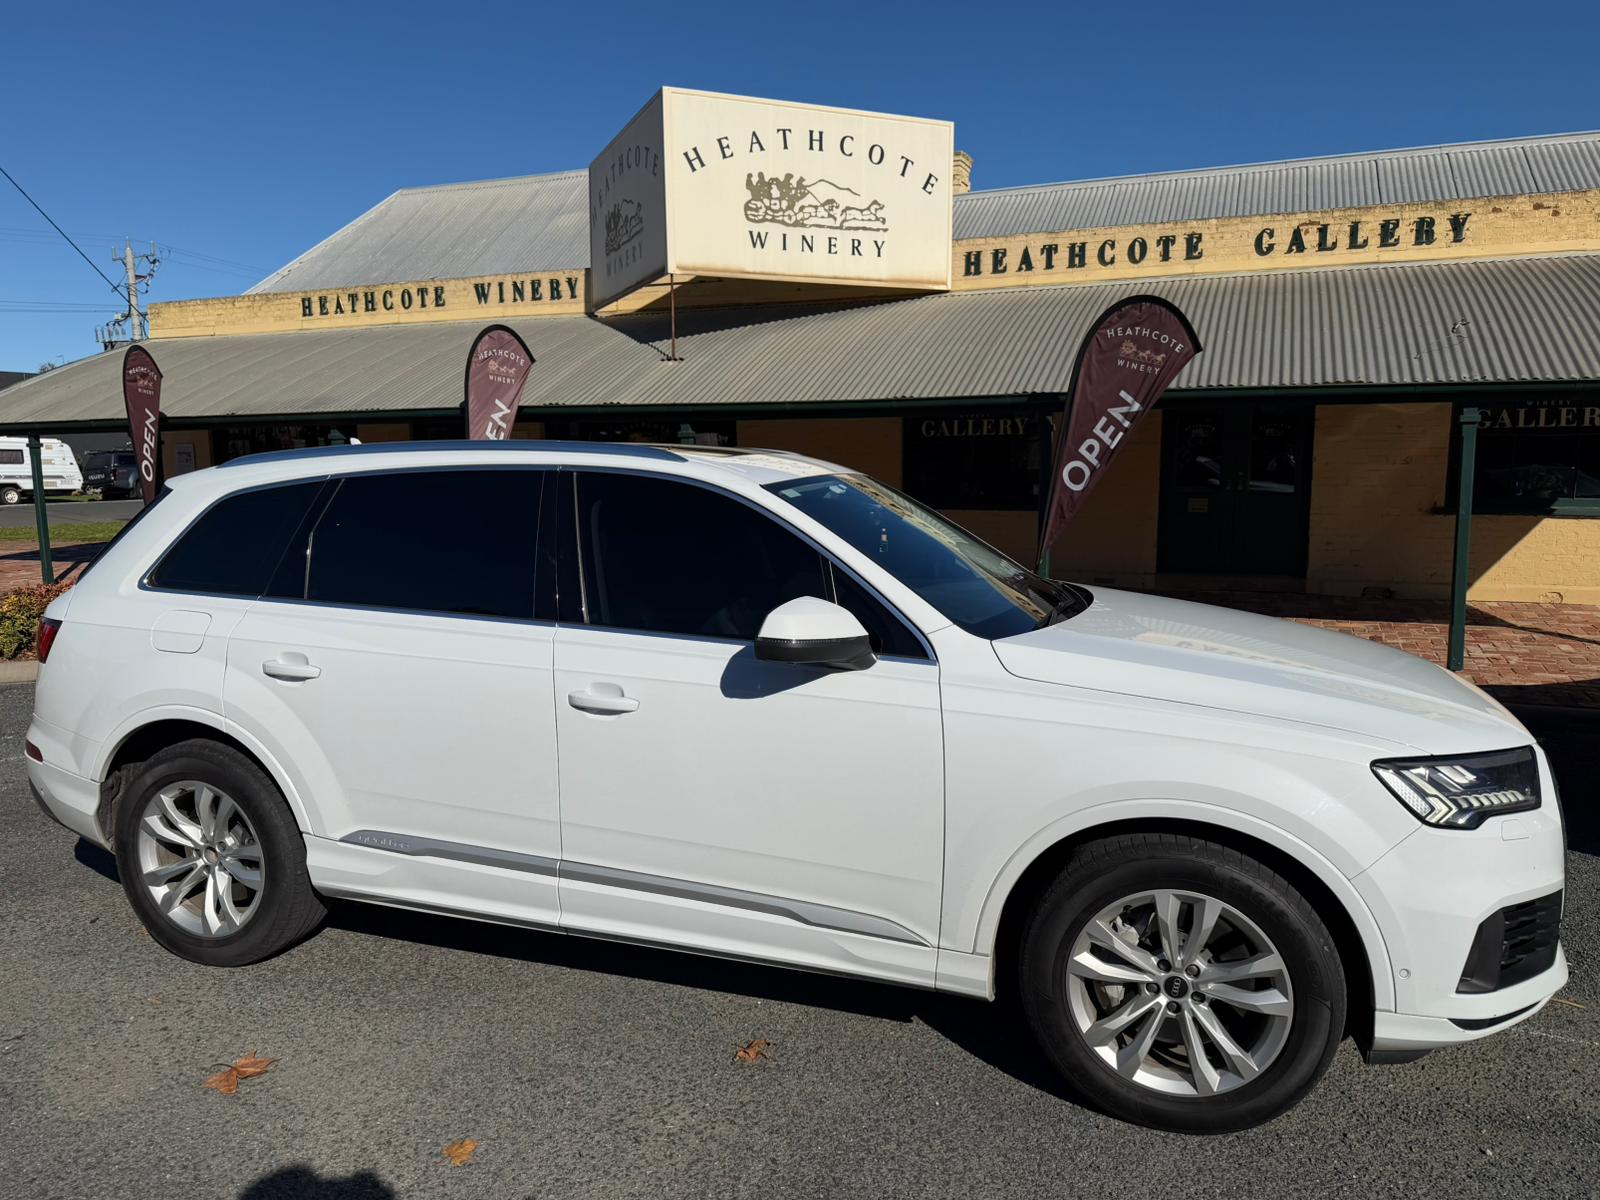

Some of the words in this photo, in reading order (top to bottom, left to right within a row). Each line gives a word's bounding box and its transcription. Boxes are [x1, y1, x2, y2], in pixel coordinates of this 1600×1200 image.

[683, 129, 939, 195] HEATHCOTE
[592, 145, 660, 228] HEATHCOTE
[606, 240, 643, 276] WINERY
[748, 230, 887, 259] WINERY
[963, 232, 1204, 277] HEATHCOTE
[1254, 213, 1472, 257] GALLERY
[301, 287, 445, 316] HEATHCOTE
[473, 276, 579, 305] WINERY
[479, 350, 525, 366] HEATHCOTE
[1107, 327, 1184, 353] HEATHCOTE
[489, 376, 515, 385] WINERY
[1117, 360, 1160, 375] WINERY
[141, 408, 156, 482] OPEN
[921, 416, 1029, 438] GALLERY
[1063, 390, 1143, 491] OPEN
